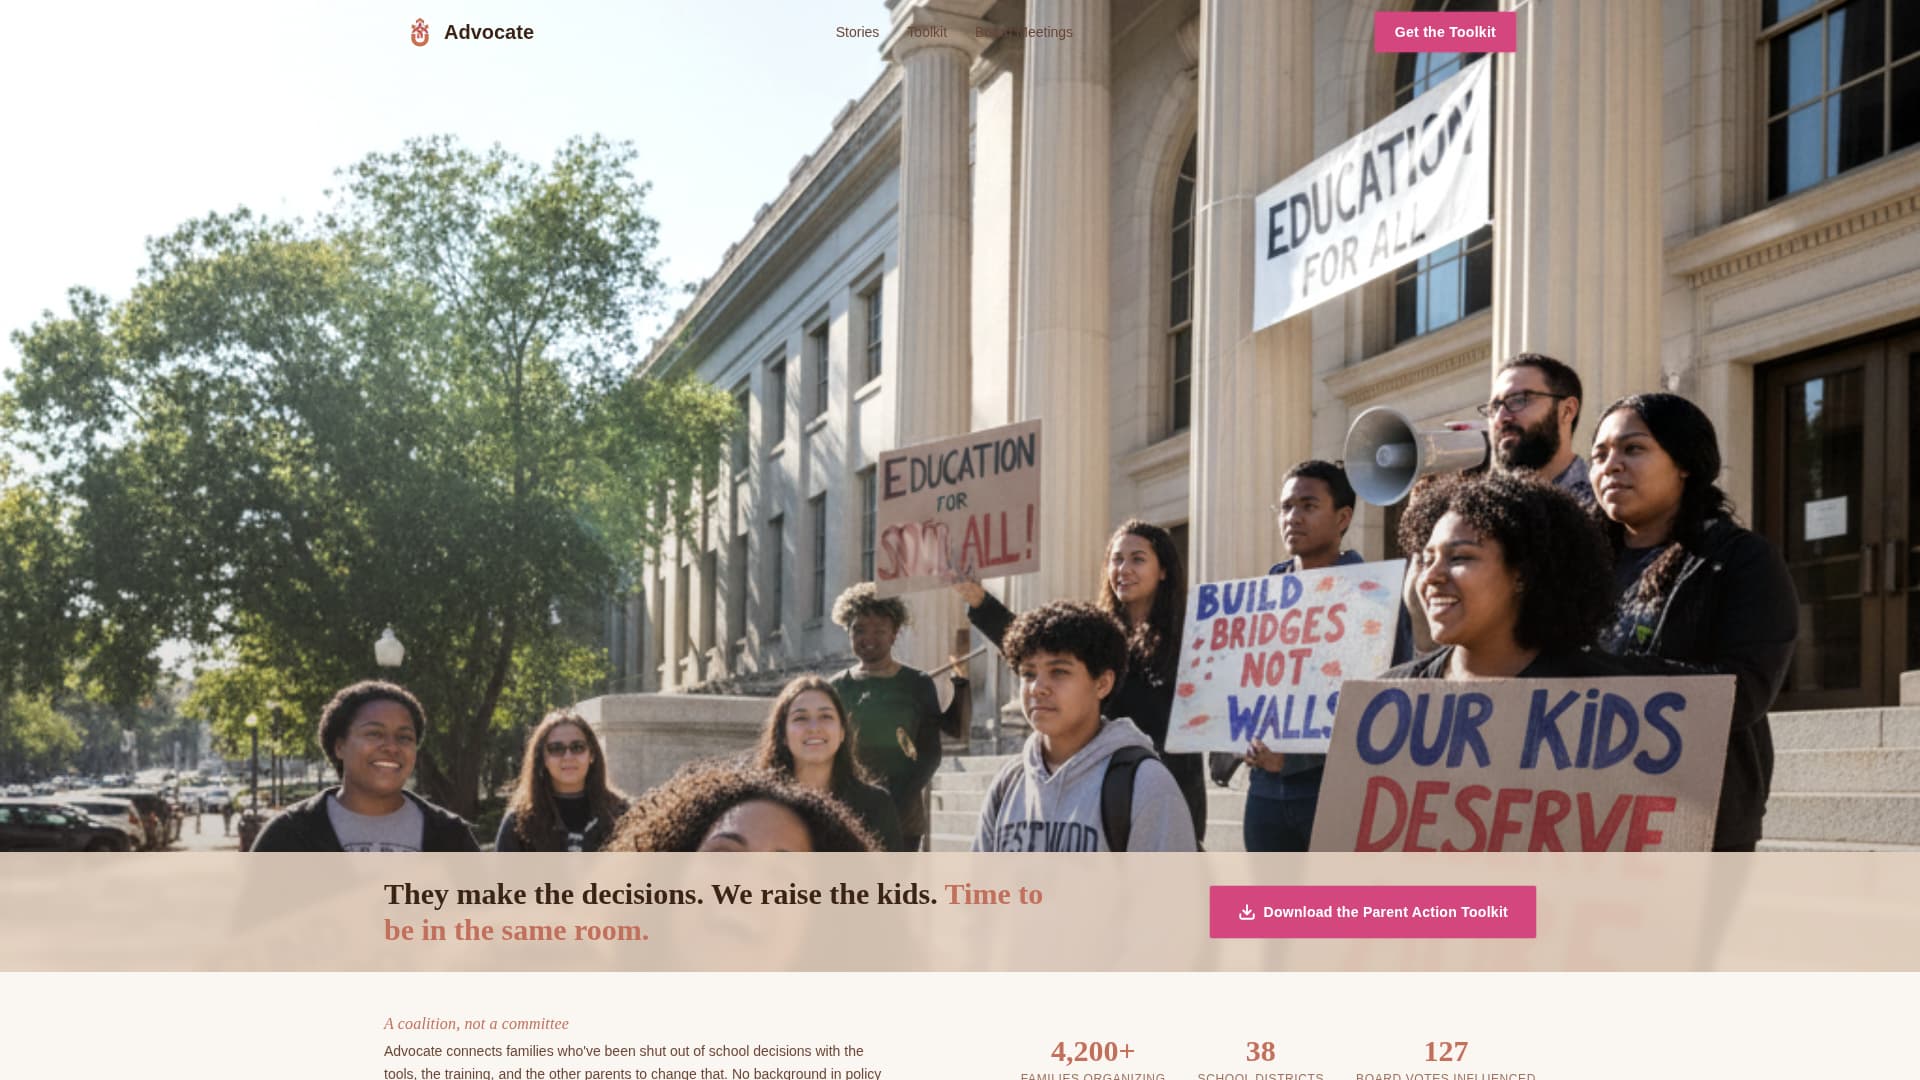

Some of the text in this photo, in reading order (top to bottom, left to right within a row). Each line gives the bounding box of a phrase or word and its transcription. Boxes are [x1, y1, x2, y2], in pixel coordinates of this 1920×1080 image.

[1267, 89, 1473, 260] EDUCATION
[1302, 202, 1426, 298] FOR ALL
[883, 432, 1035, 501] EDUCATION
[936, 492, 968, 513] FOR
[960, 504, 1035, 573] ALL!
[1196, 575, 1303, 621] BUILD
[1211, 603, 1347, 651] BRIDGES
[1241, 648, 1312, 688] NOT
[1356, 688, 1494, 769] OUR
